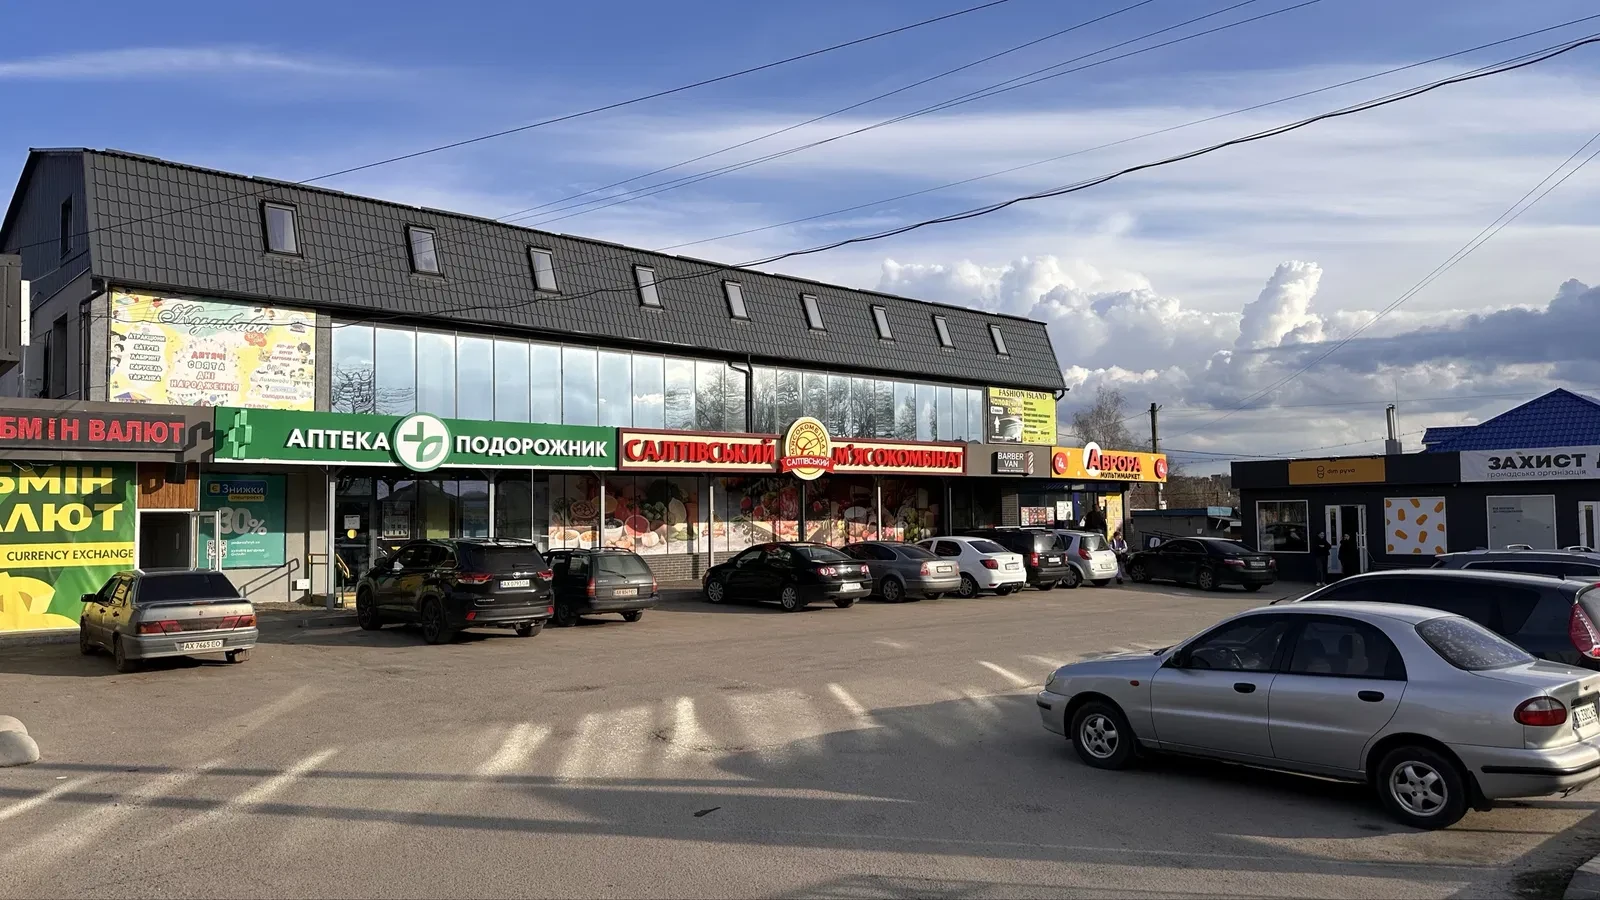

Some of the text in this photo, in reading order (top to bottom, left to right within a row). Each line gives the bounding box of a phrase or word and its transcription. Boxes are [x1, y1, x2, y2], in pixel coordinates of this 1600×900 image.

[191, 351, 226, 360] ДИТЯЧІ
[188, 360, 226, 371] СВЯТА
[170, 379, 239, 392] НАРОДЖЕННЯ
[998, 389, 1047, 400] FASHION ISLAND
[88, 419, 185, 443] ВАЛЮТ
[285, 428, 608, 457] АПТЕКА ПОДОРОЖНИК
[625, 438, 963, 468] САЛТІВСЬКИЙ М'ЯСОКОМБІНАТ
[997, 452, 1024, 460] BARBER
[786, 457, 830, 467] САЛТІВСЬКИЙ
[1488, 453, 1586, 470] ЗАХИСТ
[1100, 472, 1141, 480] МУЛЬТИМАРКЕТ
[1487, 468, 1587, 479] громадська організація
[222, 484, 264, 493] Знижки
[0, 503, 123, 532] ЛЮТ
[6, 549, 134, 562] CURRENCY EXCHANGE
